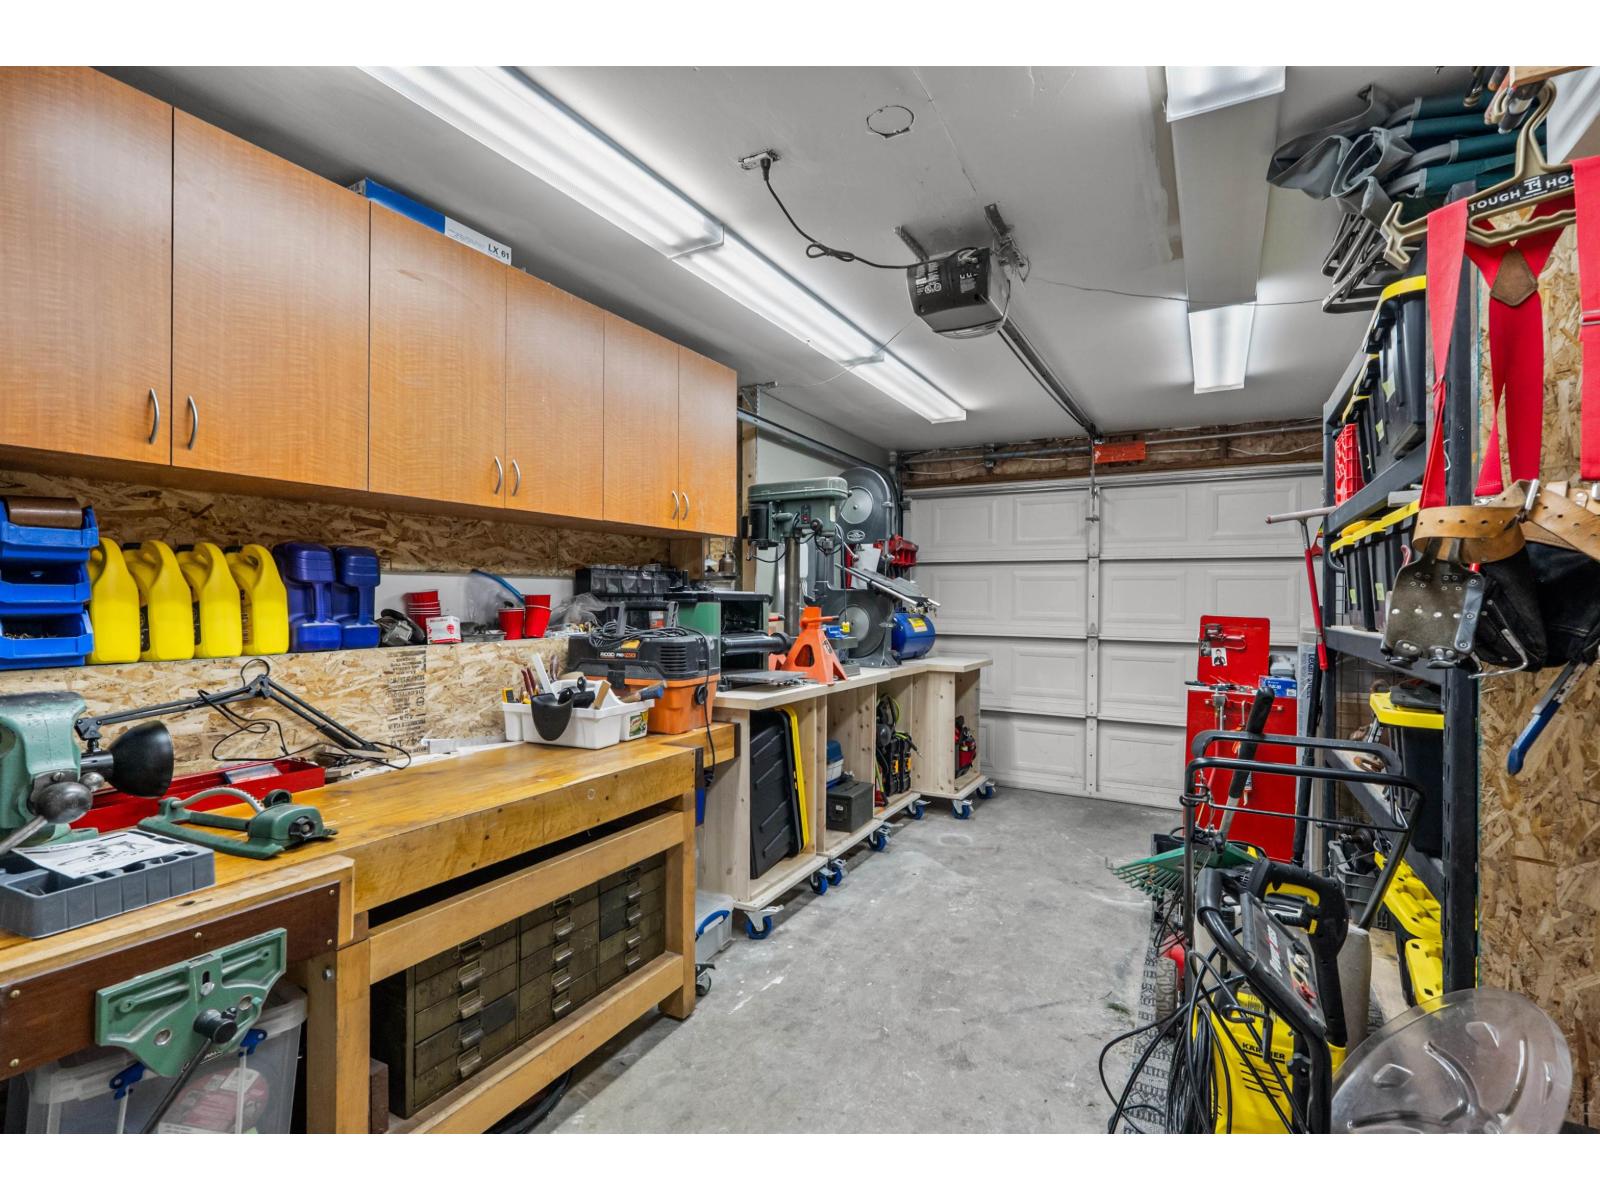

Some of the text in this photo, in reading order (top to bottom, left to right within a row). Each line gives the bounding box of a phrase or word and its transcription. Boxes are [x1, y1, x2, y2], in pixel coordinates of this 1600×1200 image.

[1469, 189, 1520, 211] TOUGH
[487, 243, 510, 260] LX 61
